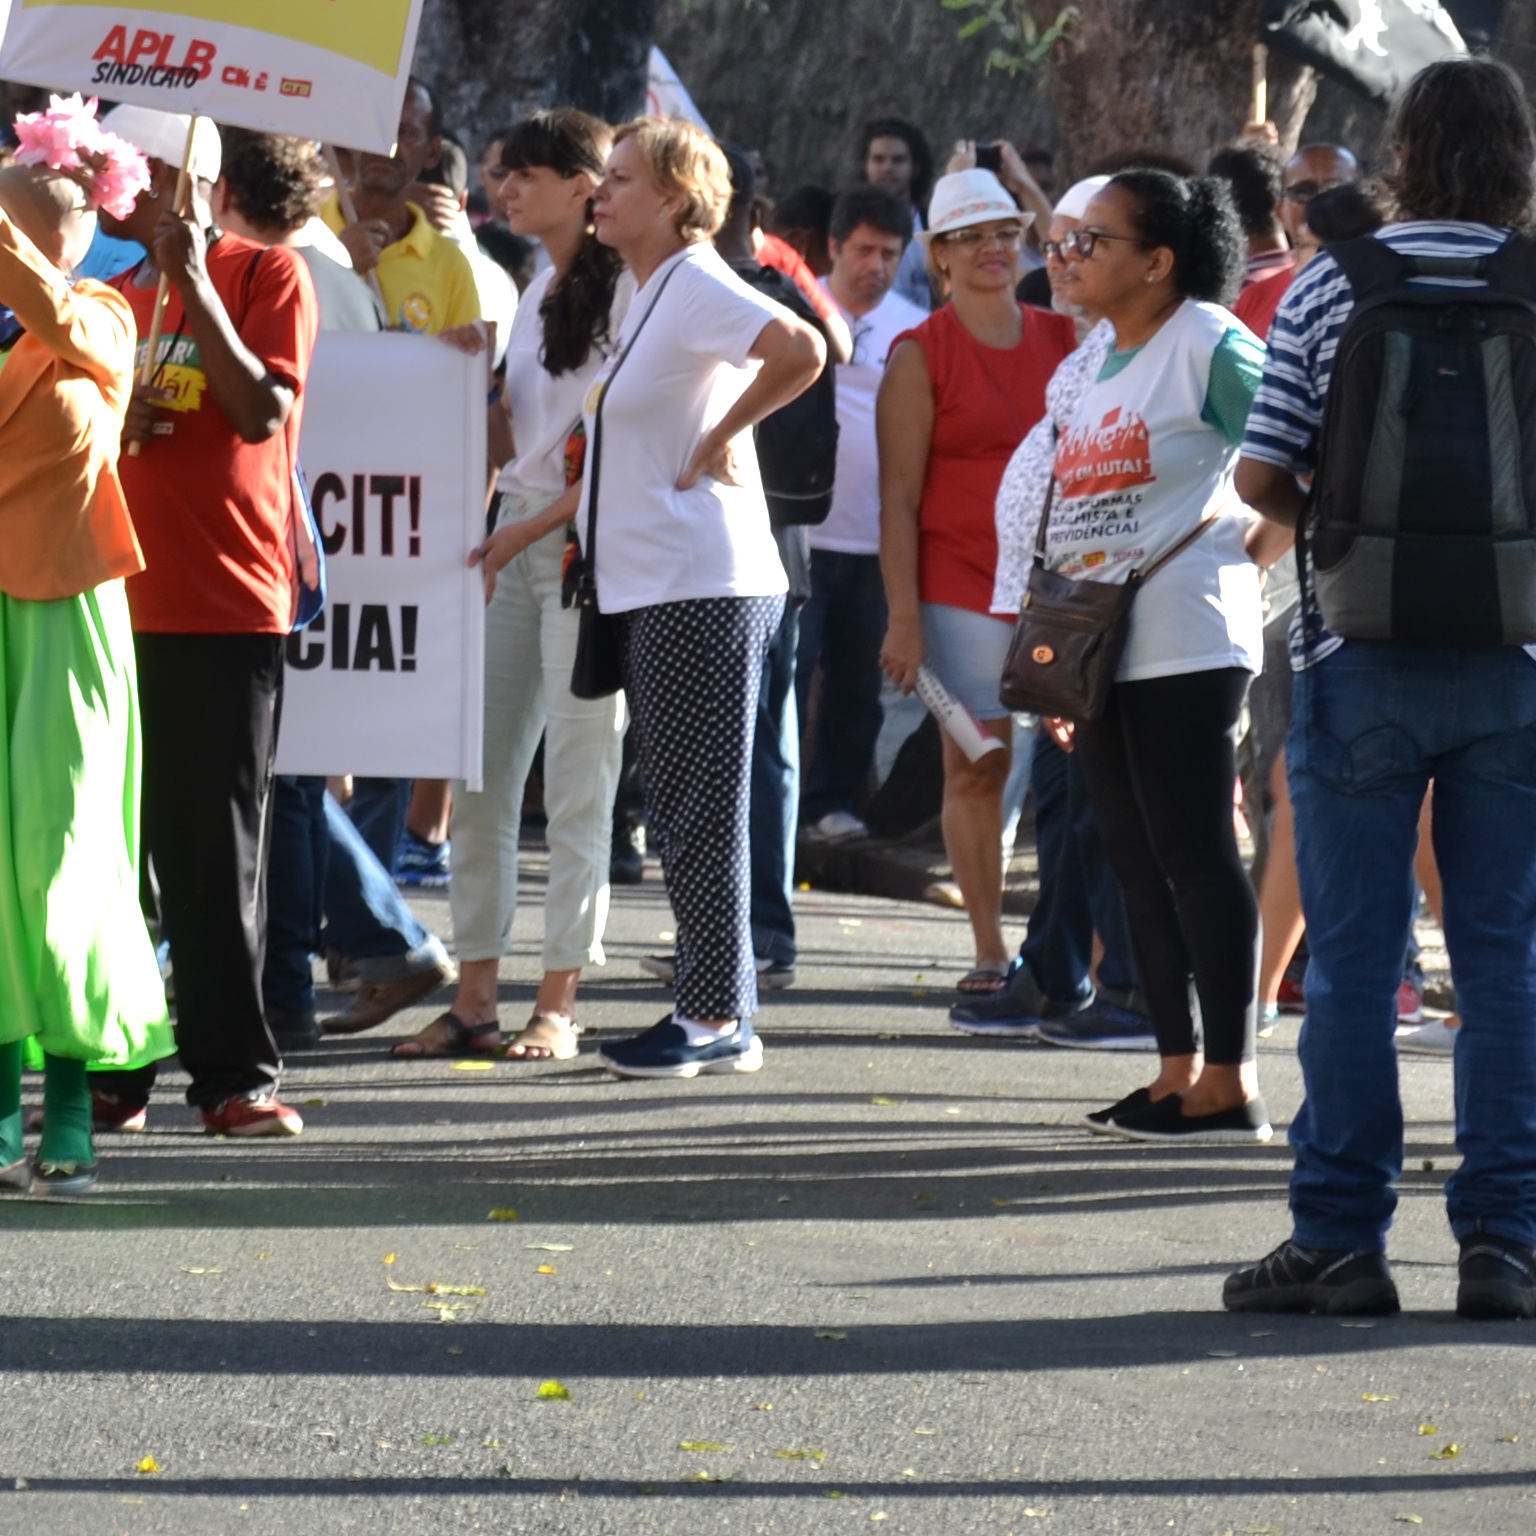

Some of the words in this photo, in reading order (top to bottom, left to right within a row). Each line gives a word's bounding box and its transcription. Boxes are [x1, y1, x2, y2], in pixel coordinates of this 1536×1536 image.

[91, 24, 218, 81] APLB
[91, 61, 201, 89] SINDICATO
[1097, 457, 1143, 477] LUTA!
